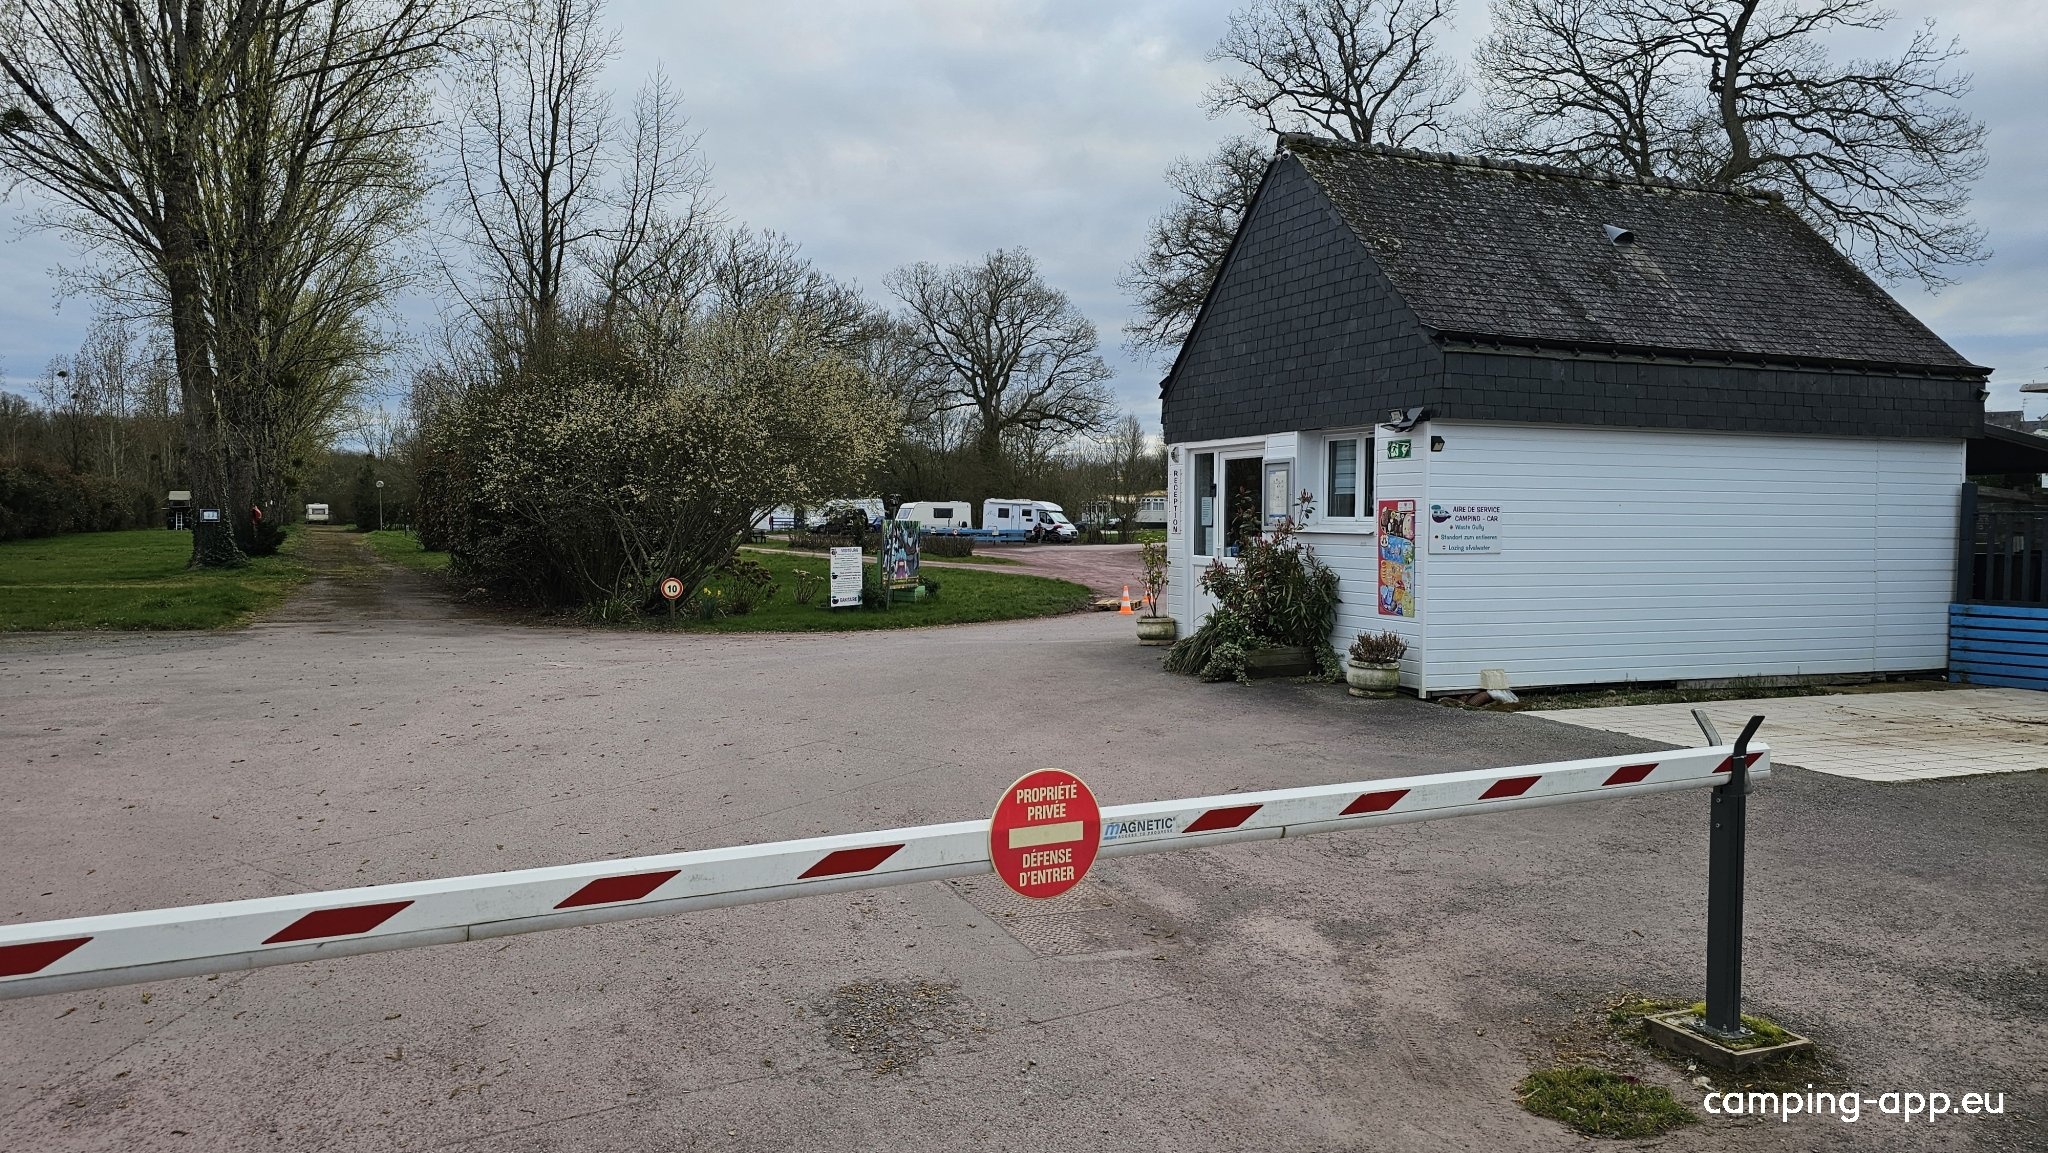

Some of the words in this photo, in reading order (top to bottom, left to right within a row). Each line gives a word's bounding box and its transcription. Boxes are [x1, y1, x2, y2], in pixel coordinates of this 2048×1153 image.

[1471, 524, 1485, 532] Gully
[1016, 780, 1078, 804] PROPRIÉTÉ
[1027, 800, 1067, 821] PRIVÉE
[1022, 848, 1072, 868] DÉFENSE
[1019, 866, 1075, 887] D'ENTRER
